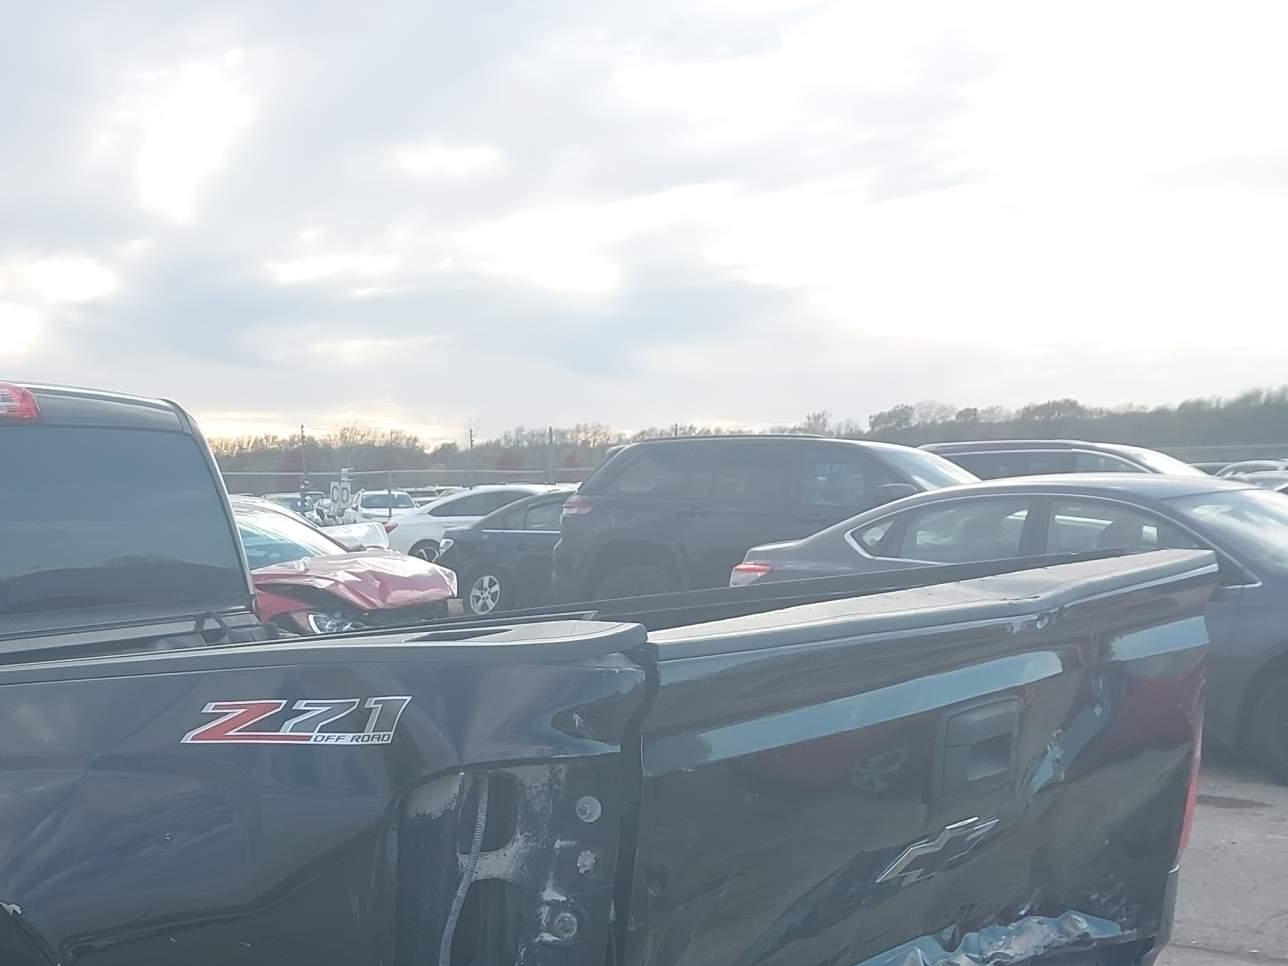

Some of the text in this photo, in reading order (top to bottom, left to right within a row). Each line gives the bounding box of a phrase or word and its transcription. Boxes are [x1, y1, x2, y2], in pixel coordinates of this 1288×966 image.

[180, 696, 412, 744] Z71
[313, 732, 391, 743] OFF ROAD
